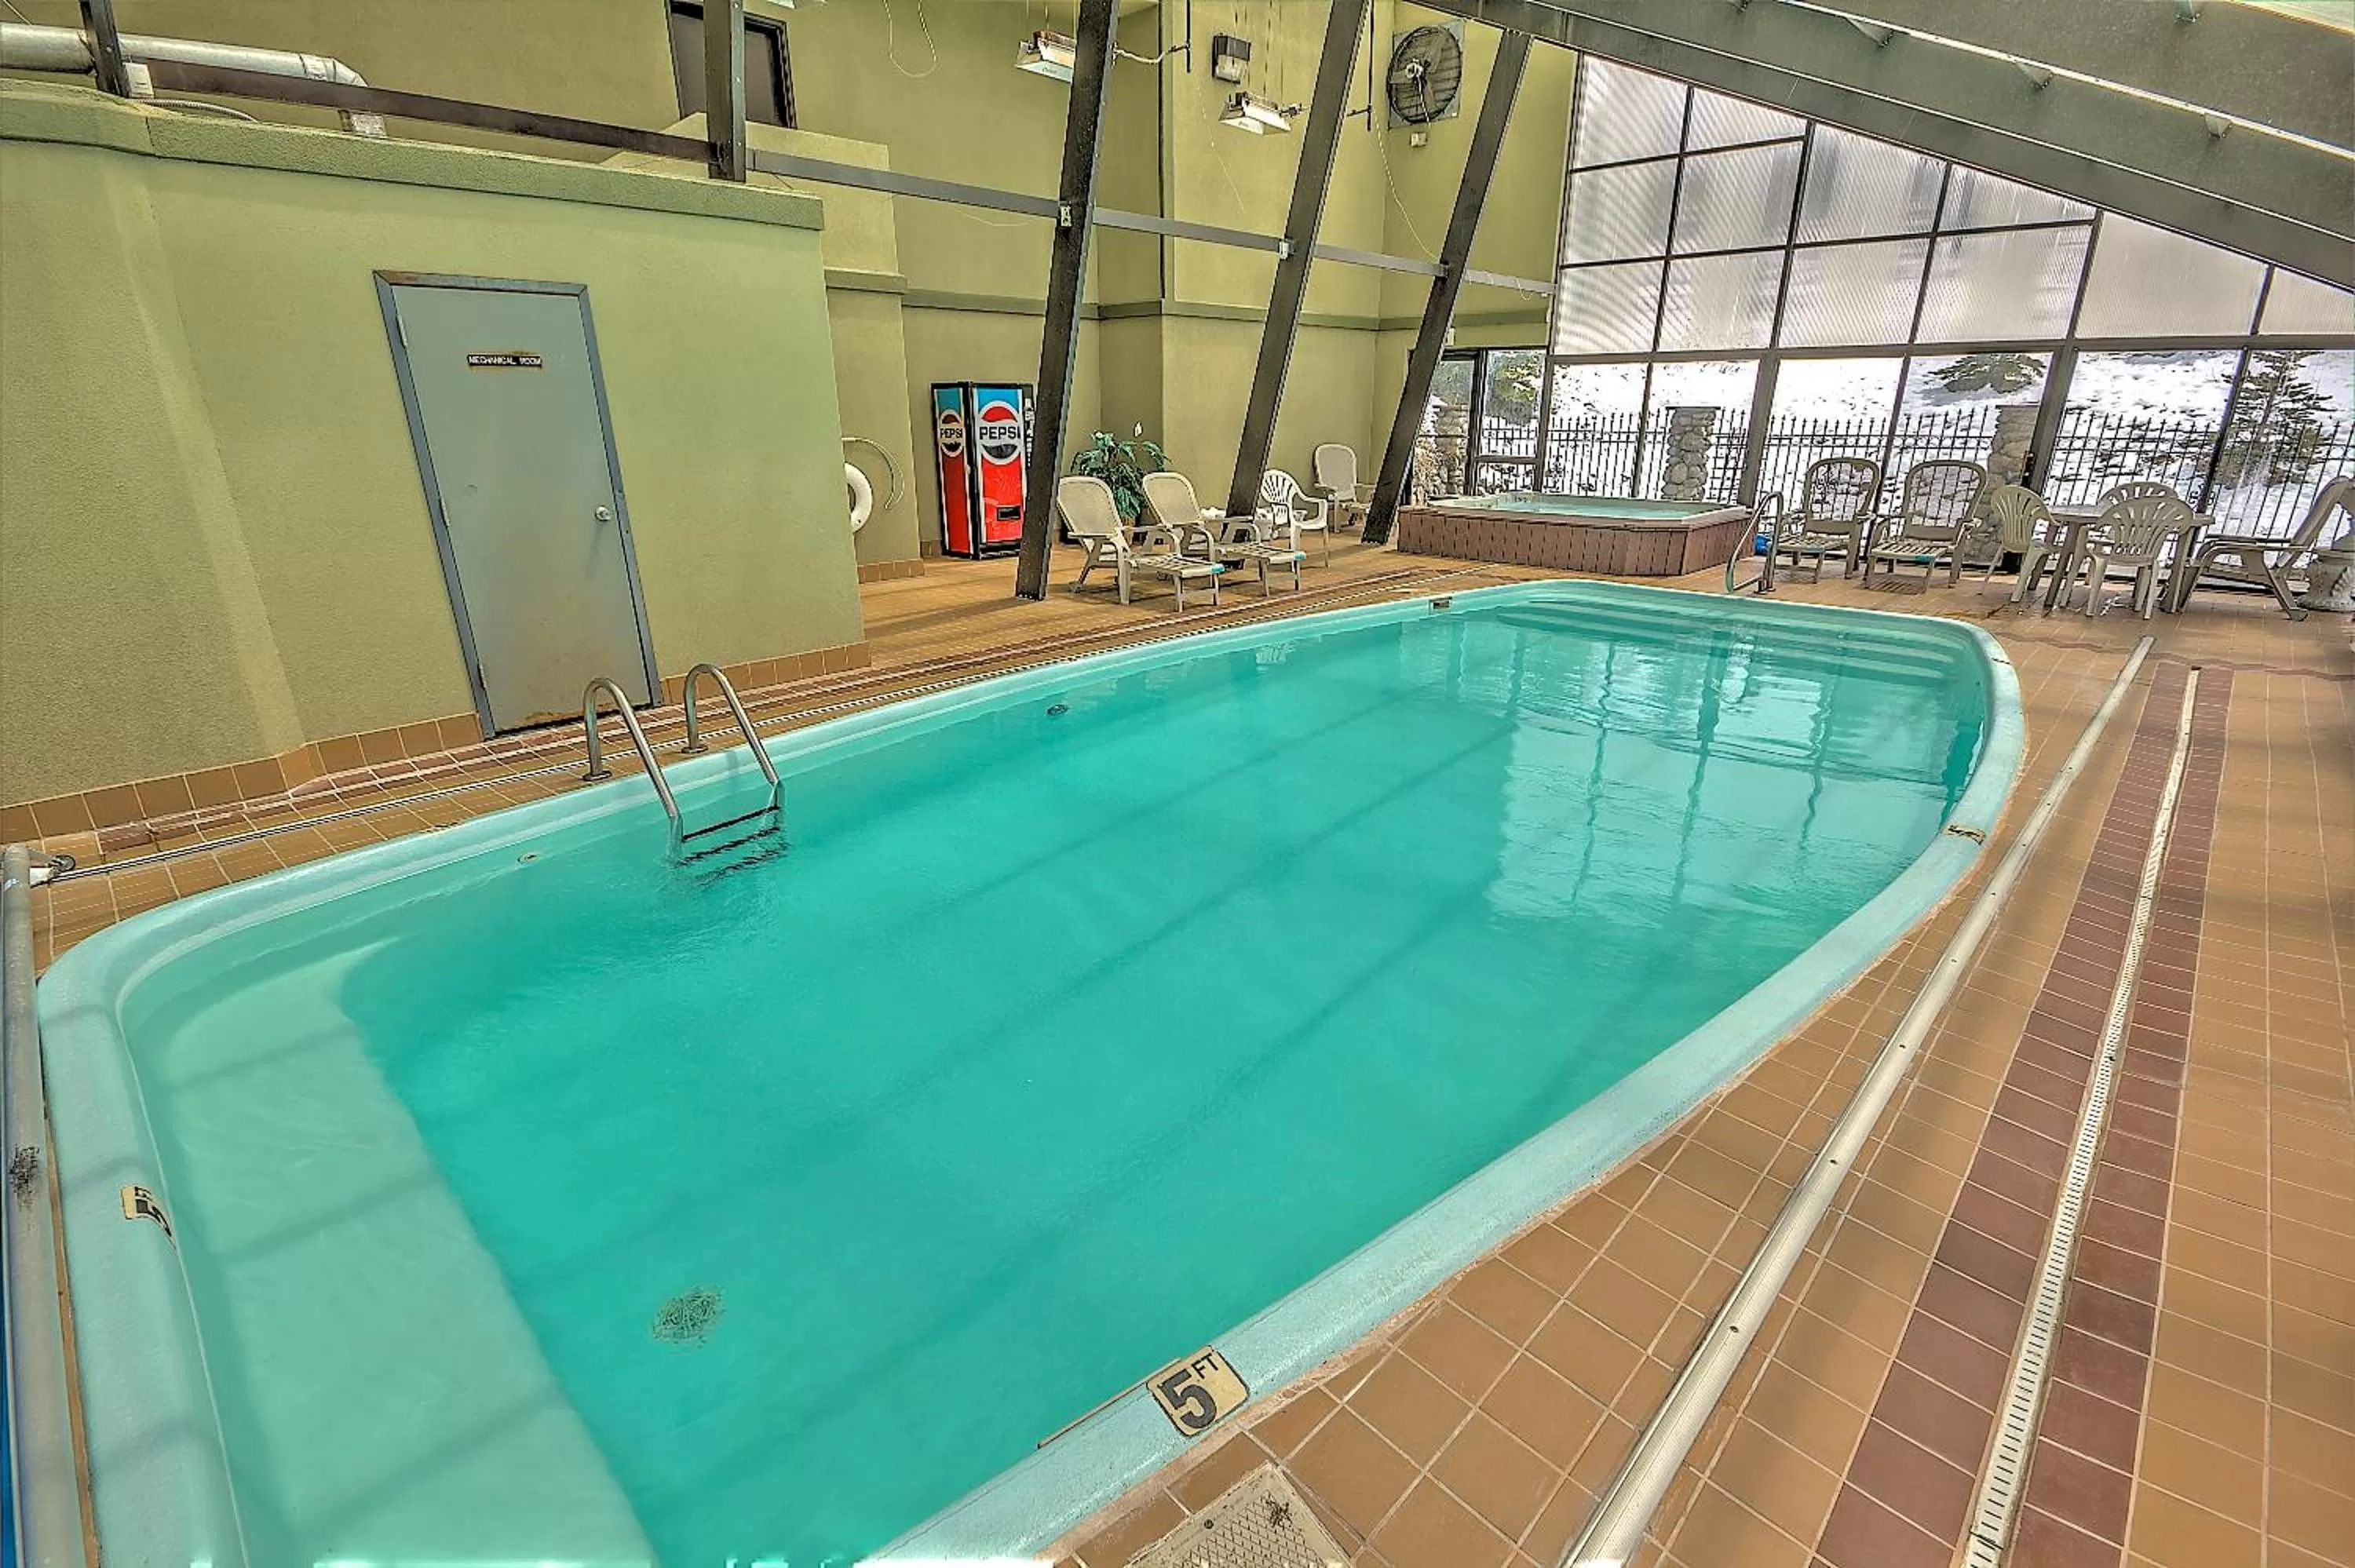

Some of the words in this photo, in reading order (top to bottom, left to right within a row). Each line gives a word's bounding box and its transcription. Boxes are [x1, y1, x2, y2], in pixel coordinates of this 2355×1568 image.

[469, 356, 517, 365] MECHANICAL
[940, 428, 963, 439] PEPSI
[979, 426, 1020, 439] PEPSI
[1157, 1369, 1217, 1428] 5
[1191, 1352, 1218, 1379] FT
